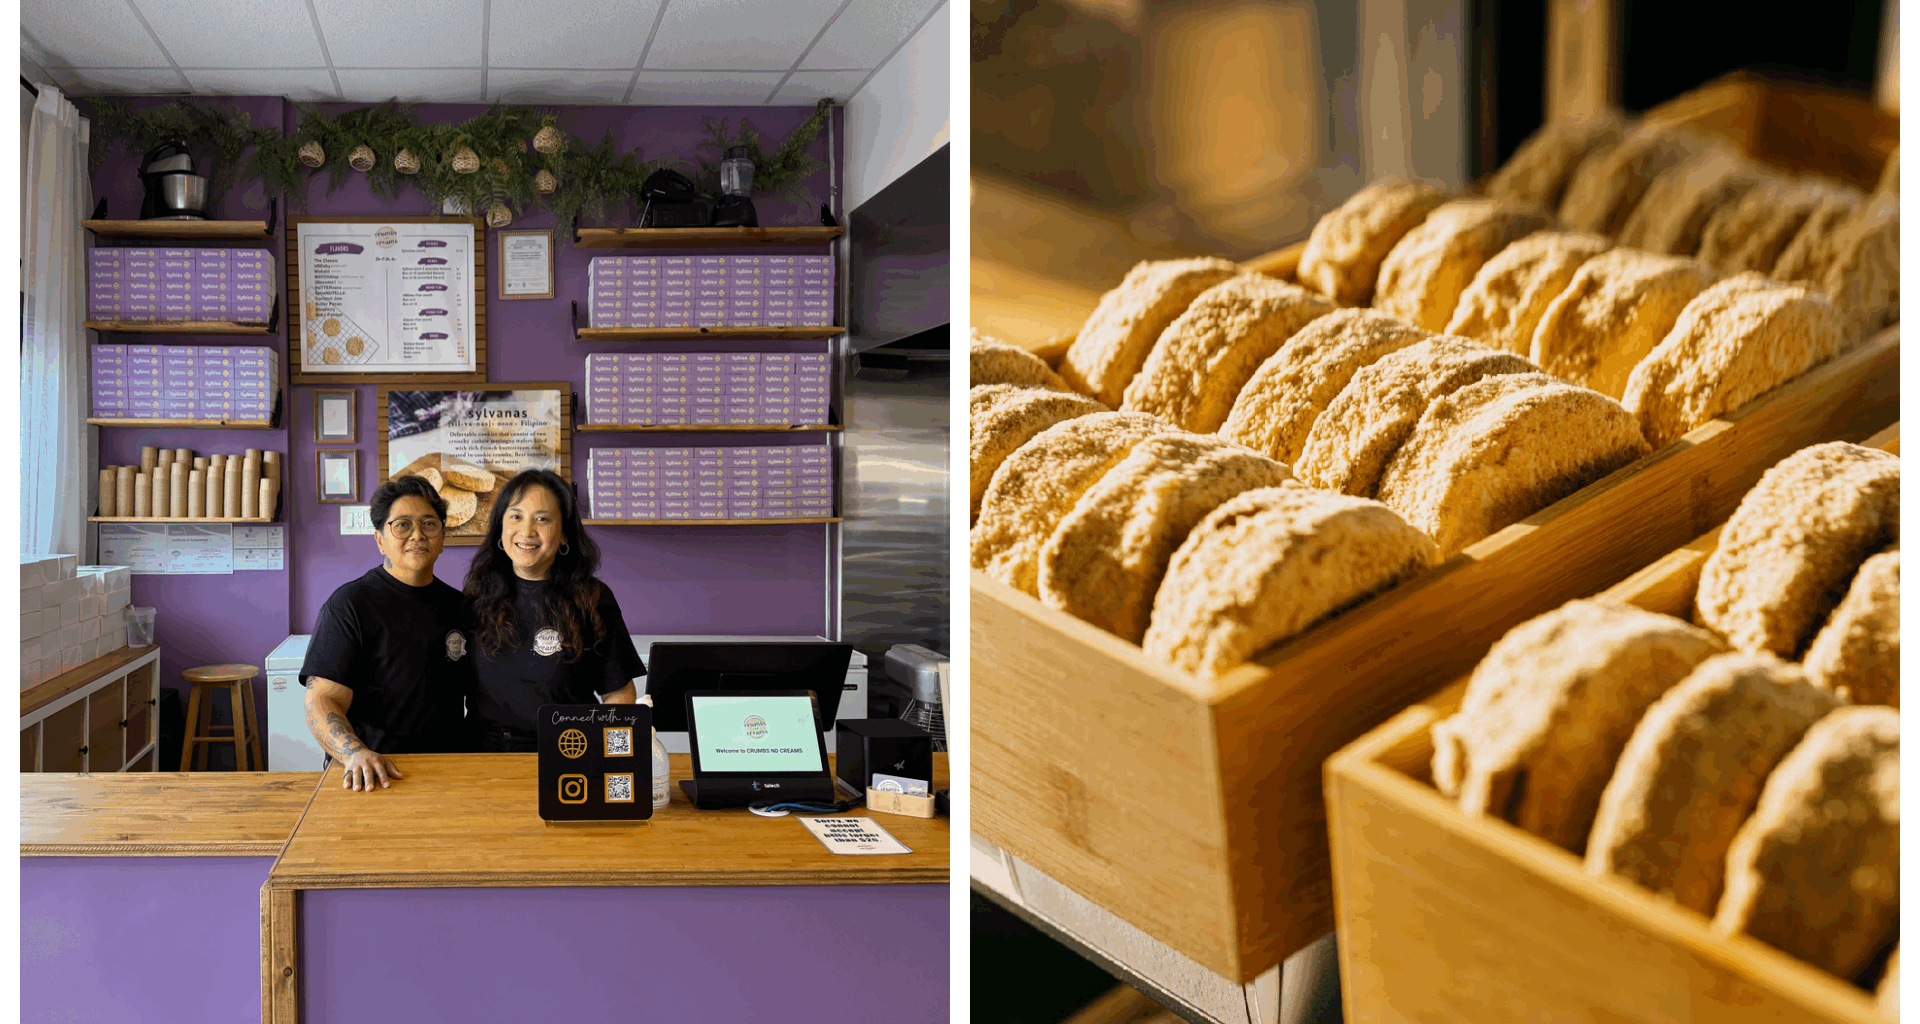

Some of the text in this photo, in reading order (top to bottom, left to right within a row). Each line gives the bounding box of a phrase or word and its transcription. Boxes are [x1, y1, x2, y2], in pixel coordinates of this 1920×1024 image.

[468, 408, 528, 420] sylvanas
[552, 707, 638, 725] Connect with us
